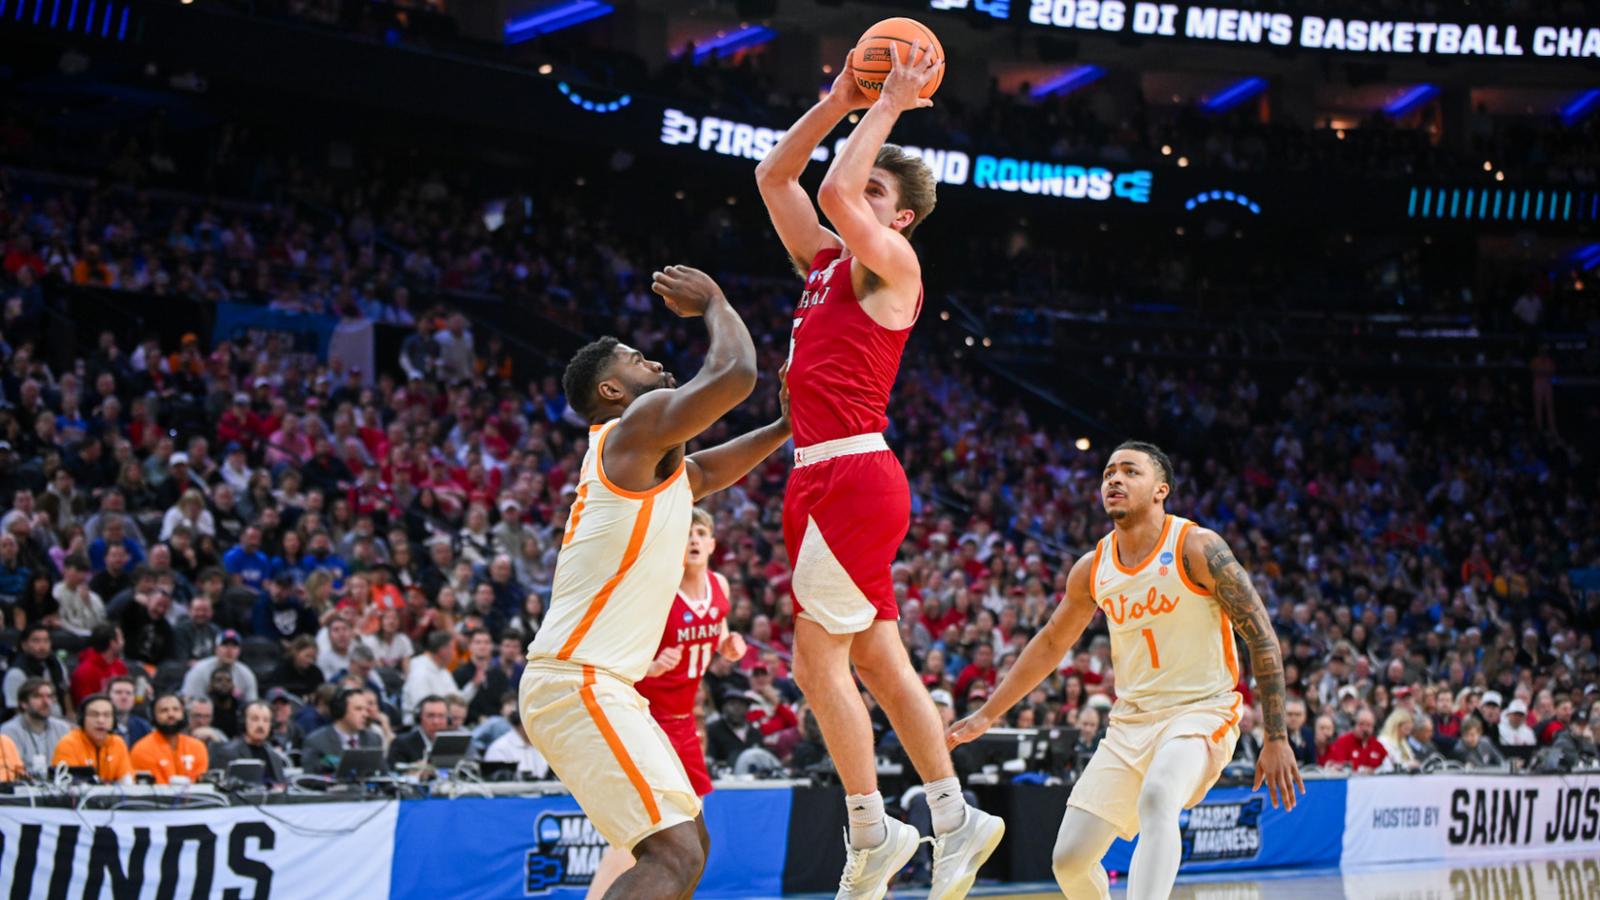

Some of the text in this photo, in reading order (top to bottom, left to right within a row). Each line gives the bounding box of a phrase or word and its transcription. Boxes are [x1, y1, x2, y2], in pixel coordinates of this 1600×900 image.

[1029, 0, 1126, 32] 2026
[1133, 2, 1179, 36] DI
[1185, 6, 1293, 46] MEN'S
[1300, 15, 1524, 55] BASKETBALL
[699, 117, 788, 162] FIRS
[974, 154, 1113, 201] ROUNDS
[1102, 586, 1181, 625] Vols
[677, 622, 722, 643] MIAM
[1141, 628, 1160, 669] 1
[688, 642, 713, 679] 11
[1372, 806, 1440, 829] HOSTED BY
[1448, 787, 1600, 846] SAINT JOS
[0, 821, 276, 900] UNDS
